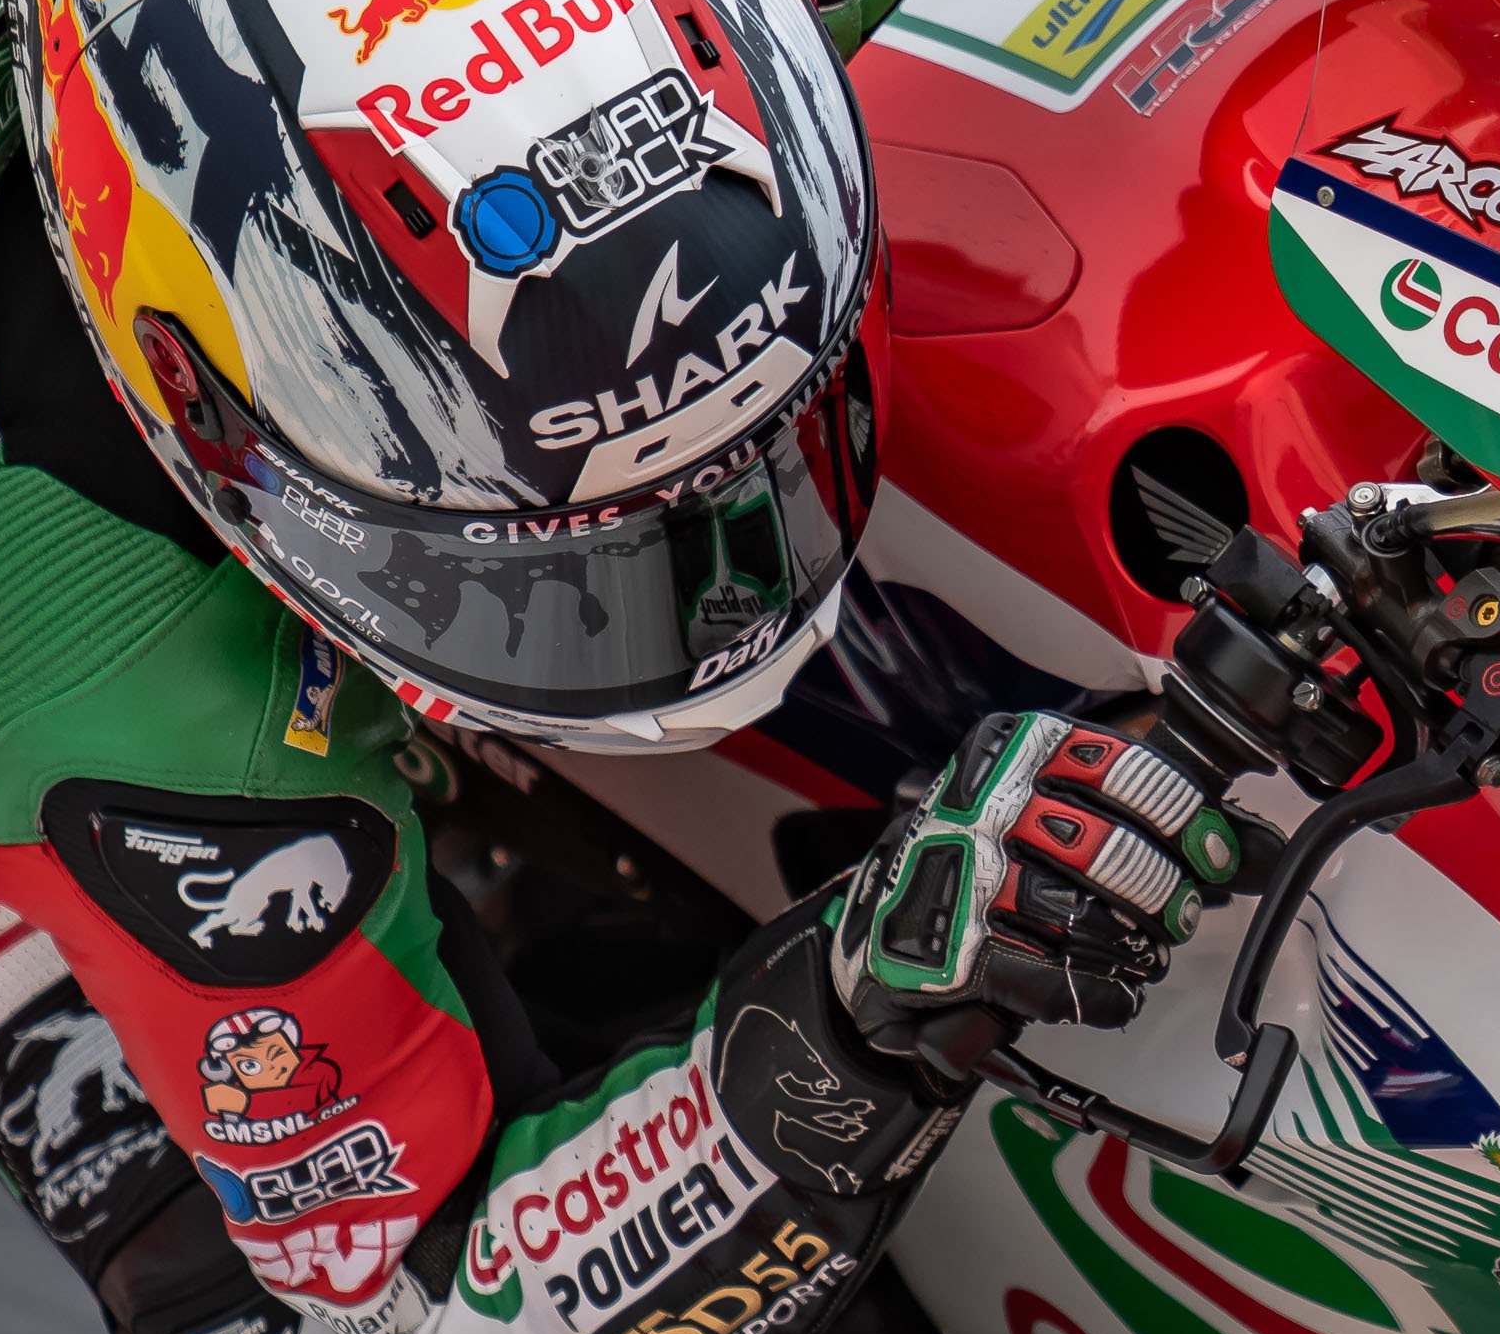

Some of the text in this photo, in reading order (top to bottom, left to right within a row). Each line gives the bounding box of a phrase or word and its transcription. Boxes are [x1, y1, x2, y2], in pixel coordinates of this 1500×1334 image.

[356, 21, 512, 157] Red
[538, 75, 693, 191] QUAD
[563, 115, 722, 231] LOCK
[529, 251, 809, 448] SHARK
[255, 443, 362, 516] SHARK
[281, 494, 364, 554] LOCK
[285, 485, 364, 542] QUAD
[462, 508, 623, 545] GIVES
[654, 438, 755, 508] YOU
[686, 615, 786, 694] Dafy
[250, 1128, 383, 1200] QUAD
[257, 1167, 392, 1220] LOCK
[511, 1067, 715, 1262] Castrol
